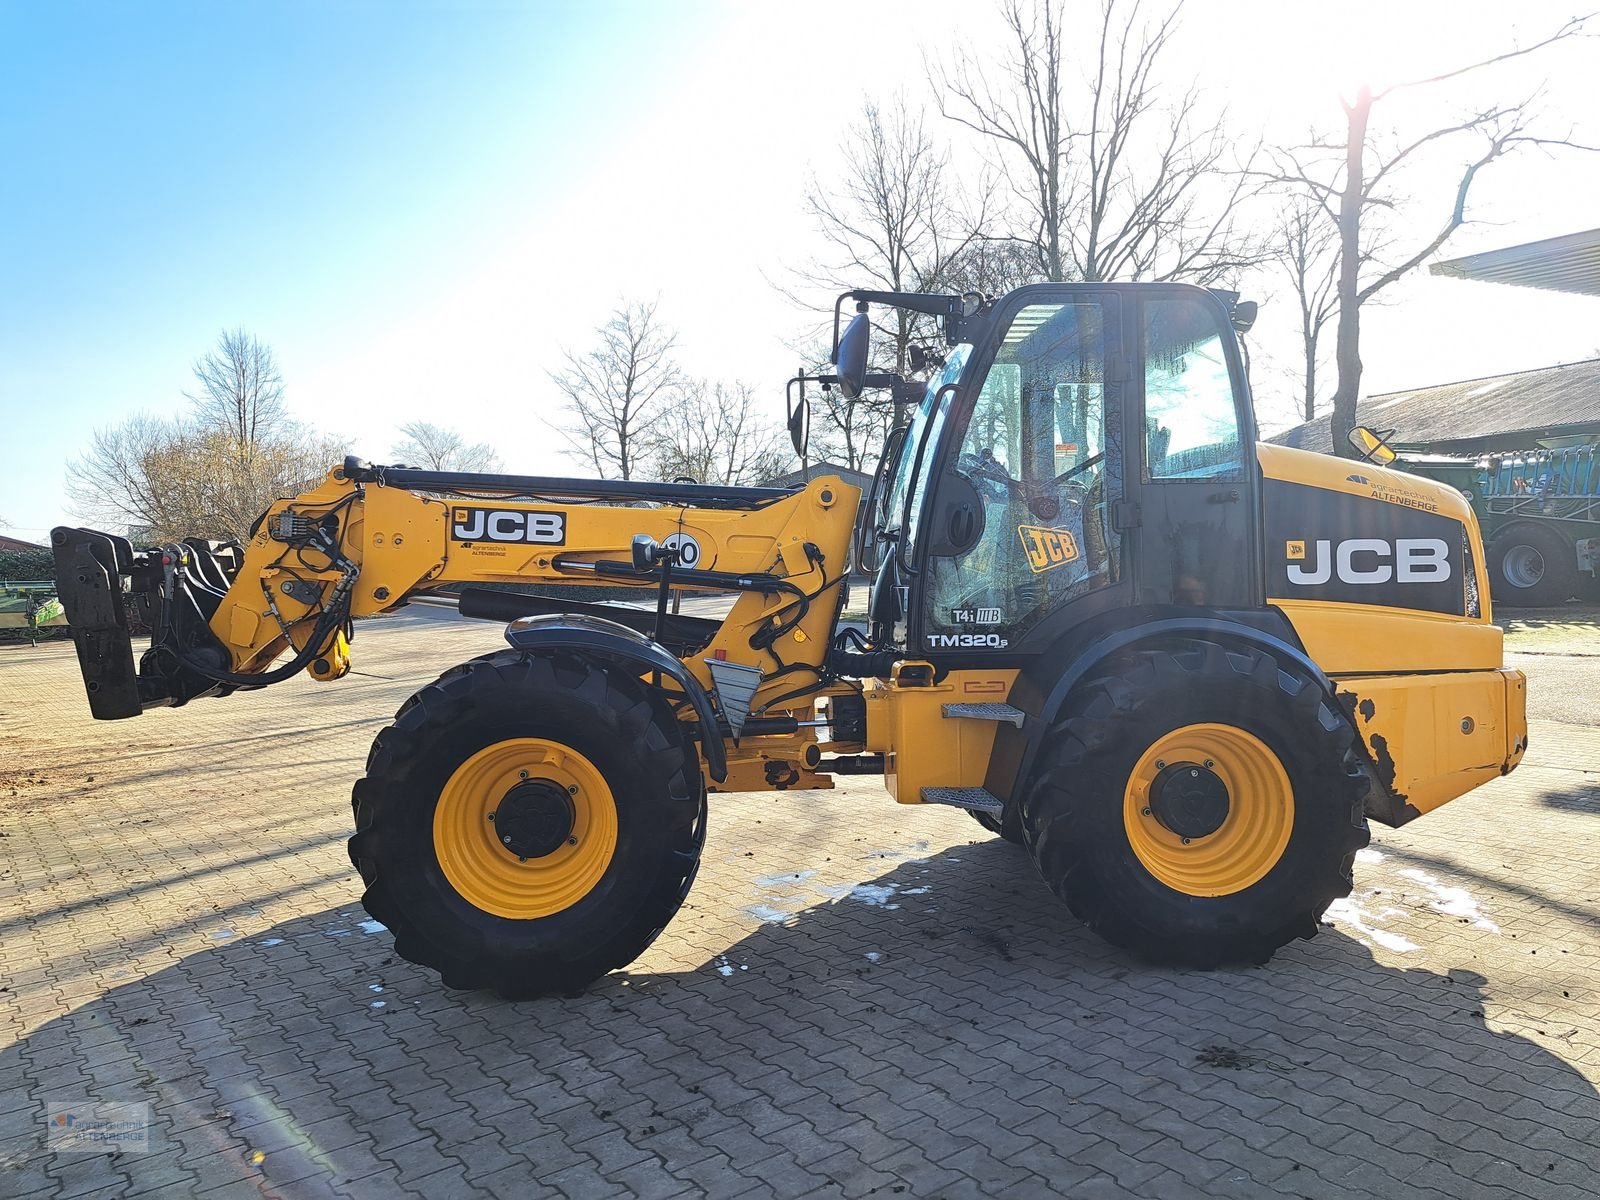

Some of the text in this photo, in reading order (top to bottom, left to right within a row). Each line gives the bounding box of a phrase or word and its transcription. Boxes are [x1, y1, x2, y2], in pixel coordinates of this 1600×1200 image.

[1370, 482, 1437, 503] agrartechnik
[1370, 490, 1438, 512] ALTENBERGE
[454, 510, 564, 543] JCB
[1028, 529, 1076, 567] JCB
[1286, 538, 1451, 585] JCB
[953, 609, 976, 623] T4i
